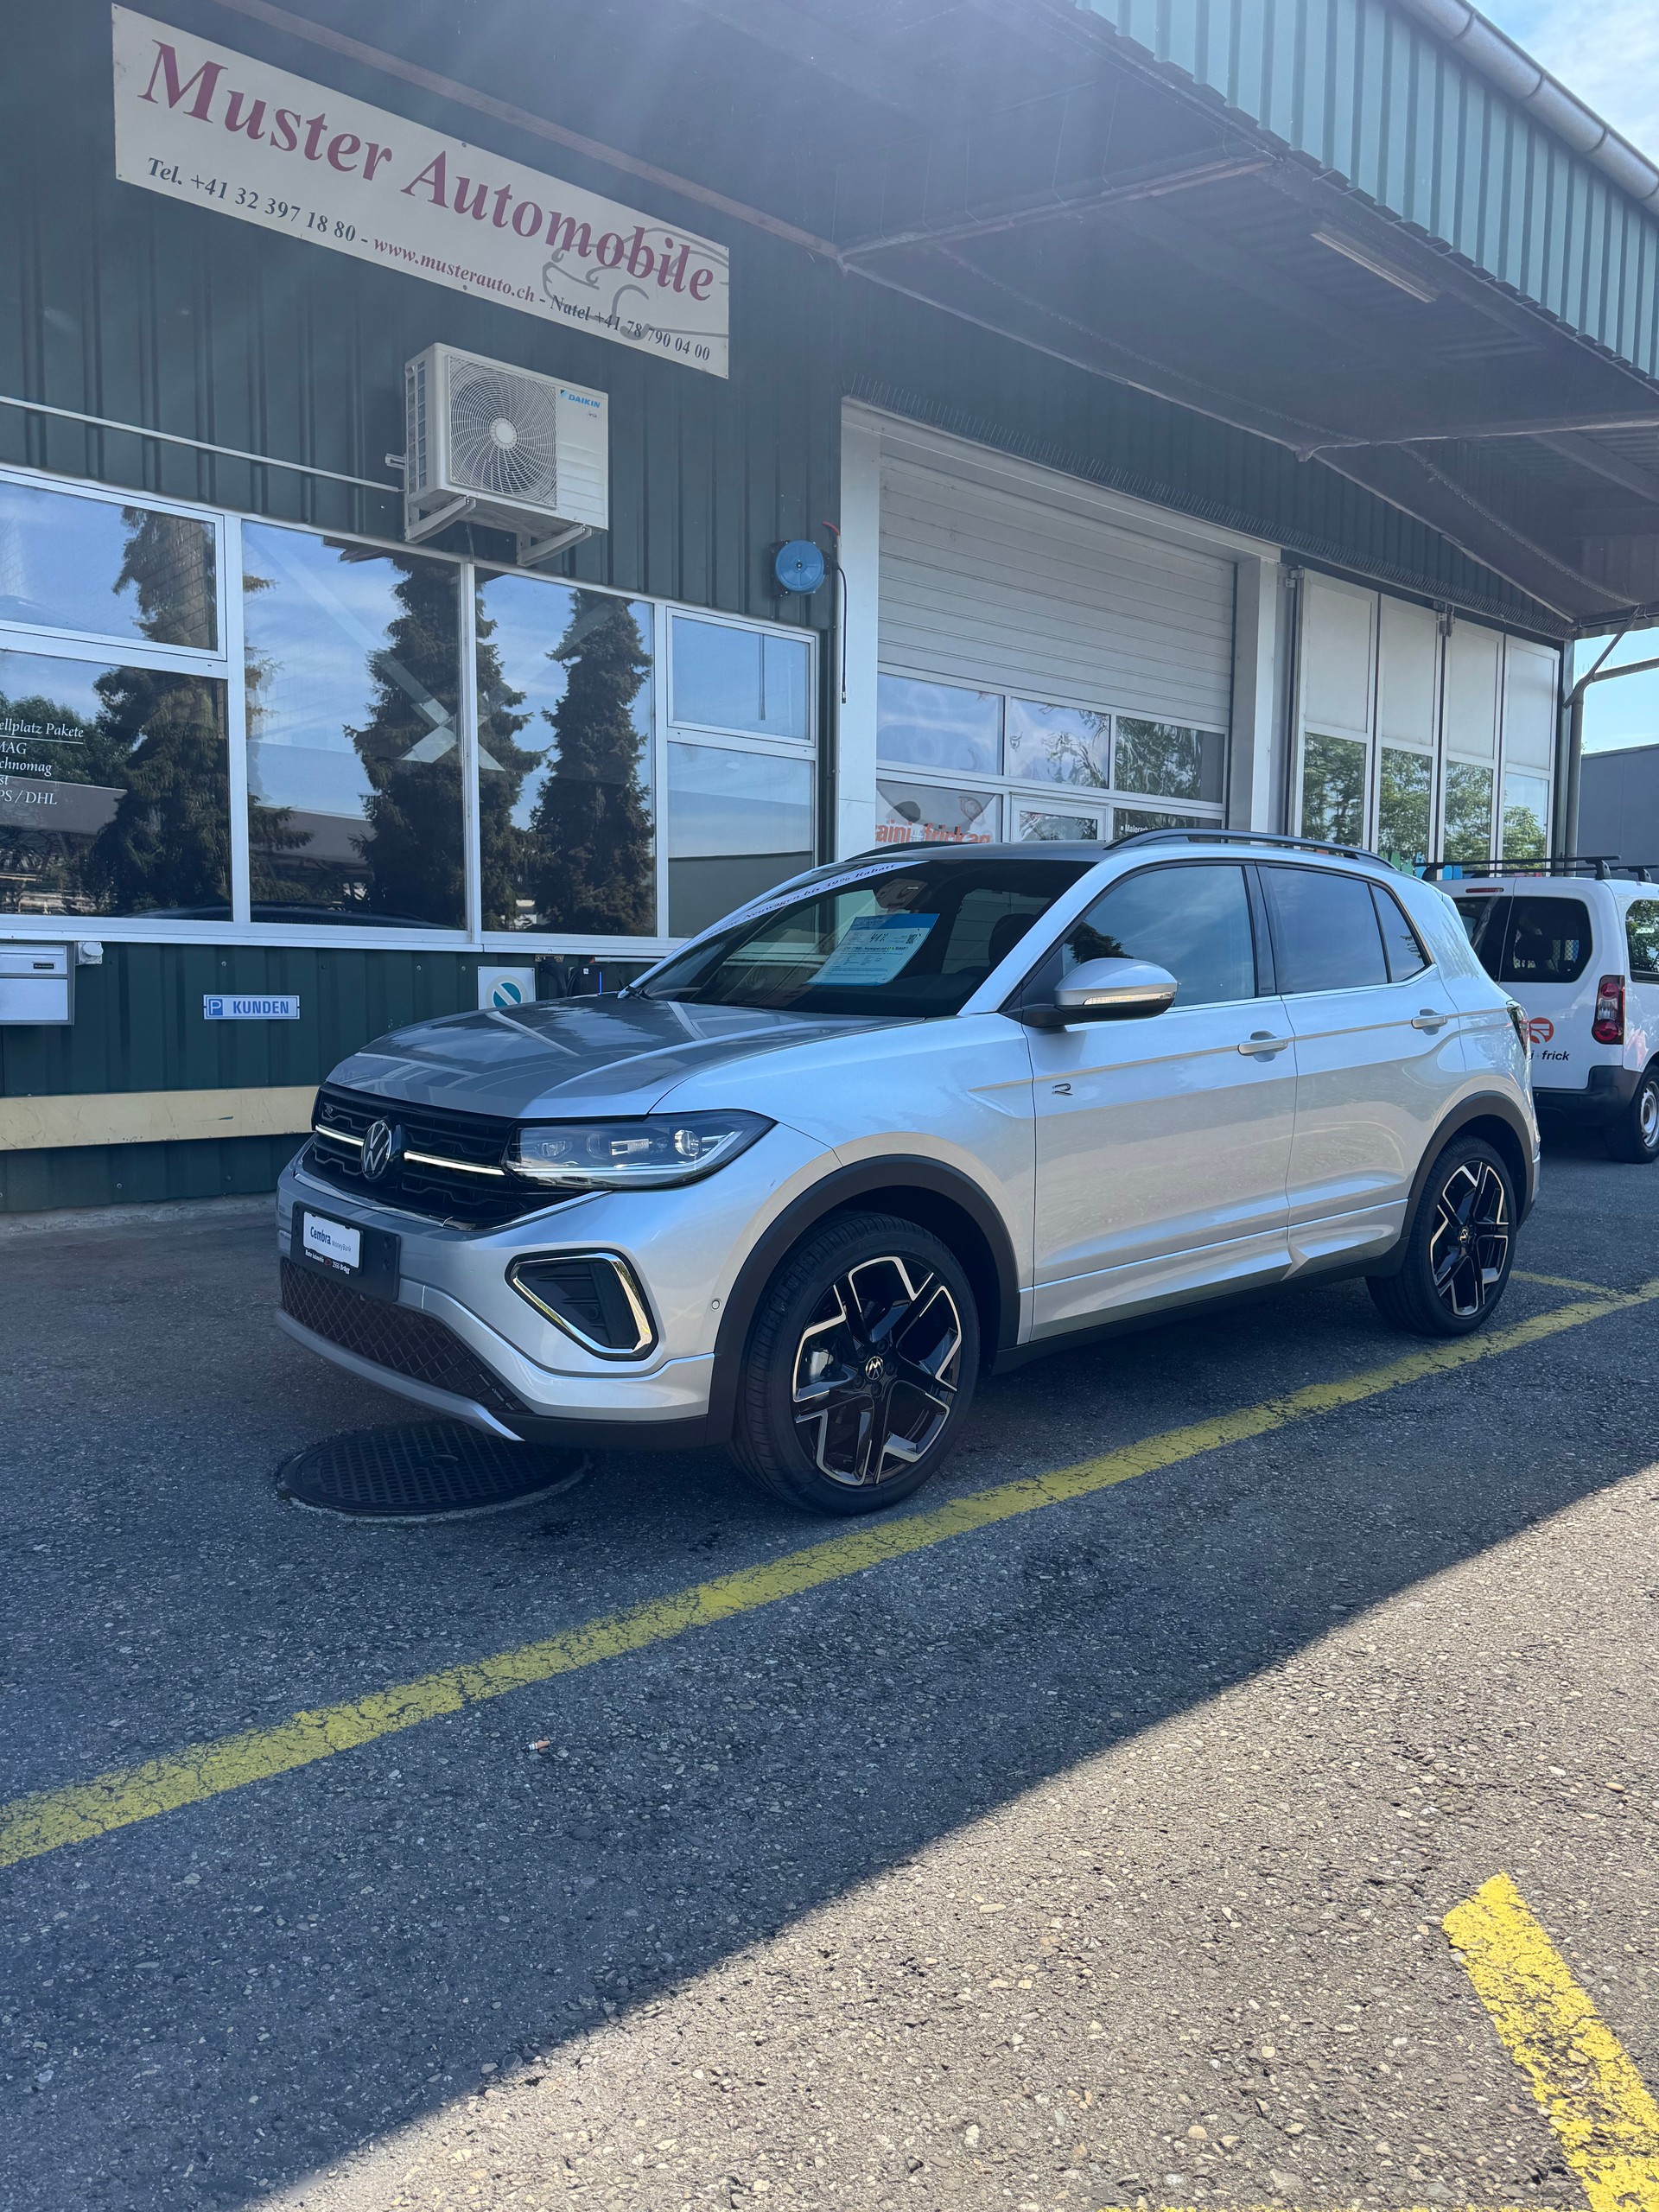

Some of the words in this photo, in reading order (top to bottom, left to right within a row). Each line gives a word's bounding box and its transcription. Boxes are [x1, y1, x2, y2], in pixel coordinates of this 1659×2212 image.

[137, 39, 392, 181] Muster
[400, 150, 714, 301] Automobile
[149, 157, 182, 185] Tel.
[190, 174, 227, 200] +41
[234, 188, 259, 210] 32
[264, 197, 301, 222] 397
[306, 212, 327, 232] 18
[334, 220, 356, 242] 80
[373, 238, 536, 302] www.musterauto.ch
[550, 295, 591, 321] Natel
[594, 312, 620, 331] +41
[626, 320, 643, 339] 78
[648, 327, 671, 347] 790
[675, 337, 690, 354] 04
[695, 344, 710, 361] 00
[569, 393, 601, 409] DAIKIN
[45, 722, 84, 738] Pakete
[25, 791, 58, 805] DHL
[232, 1001, 289, 1014] KUNDEN
[310, 1225, 332, 1245] Cembra
